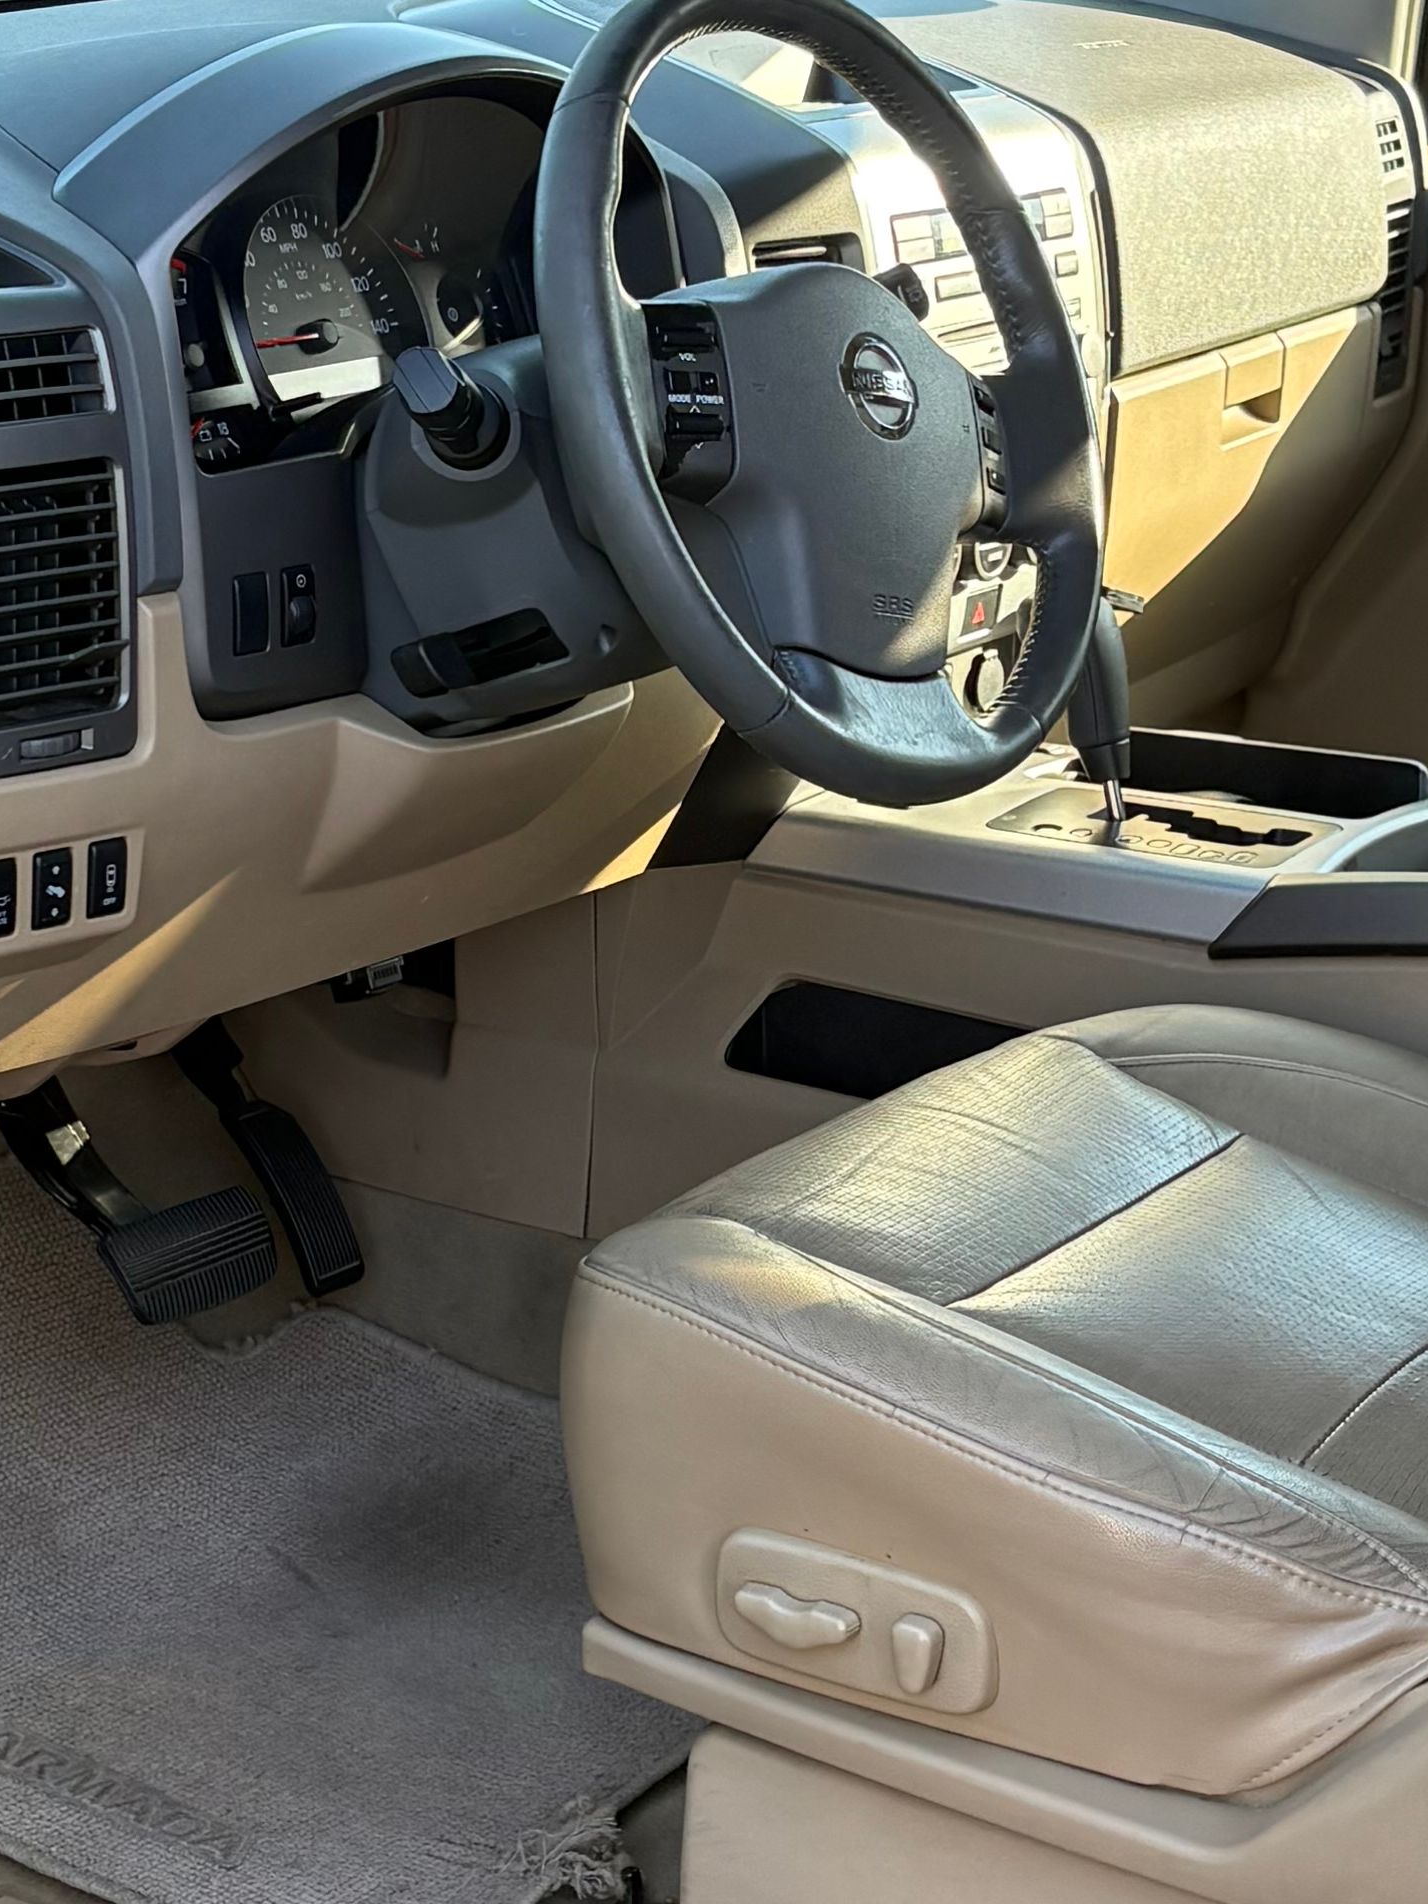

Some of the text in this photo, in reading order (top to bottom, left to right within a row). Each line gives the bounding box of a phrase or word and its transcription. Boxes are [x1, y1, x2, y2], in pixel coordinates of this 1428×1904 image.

[260, 223, 308, 243] 60 80
[279, 243, 299, 253] MPH
[322, 242, 342, 259] 100
[351, 277, 370, 293] 120
[370, 318, 390, 334] 140
[678, 352, 697, 362] VOL
[668, 394, 724, 405] MODE POWER
[873, 594, 914, 613] SRS
